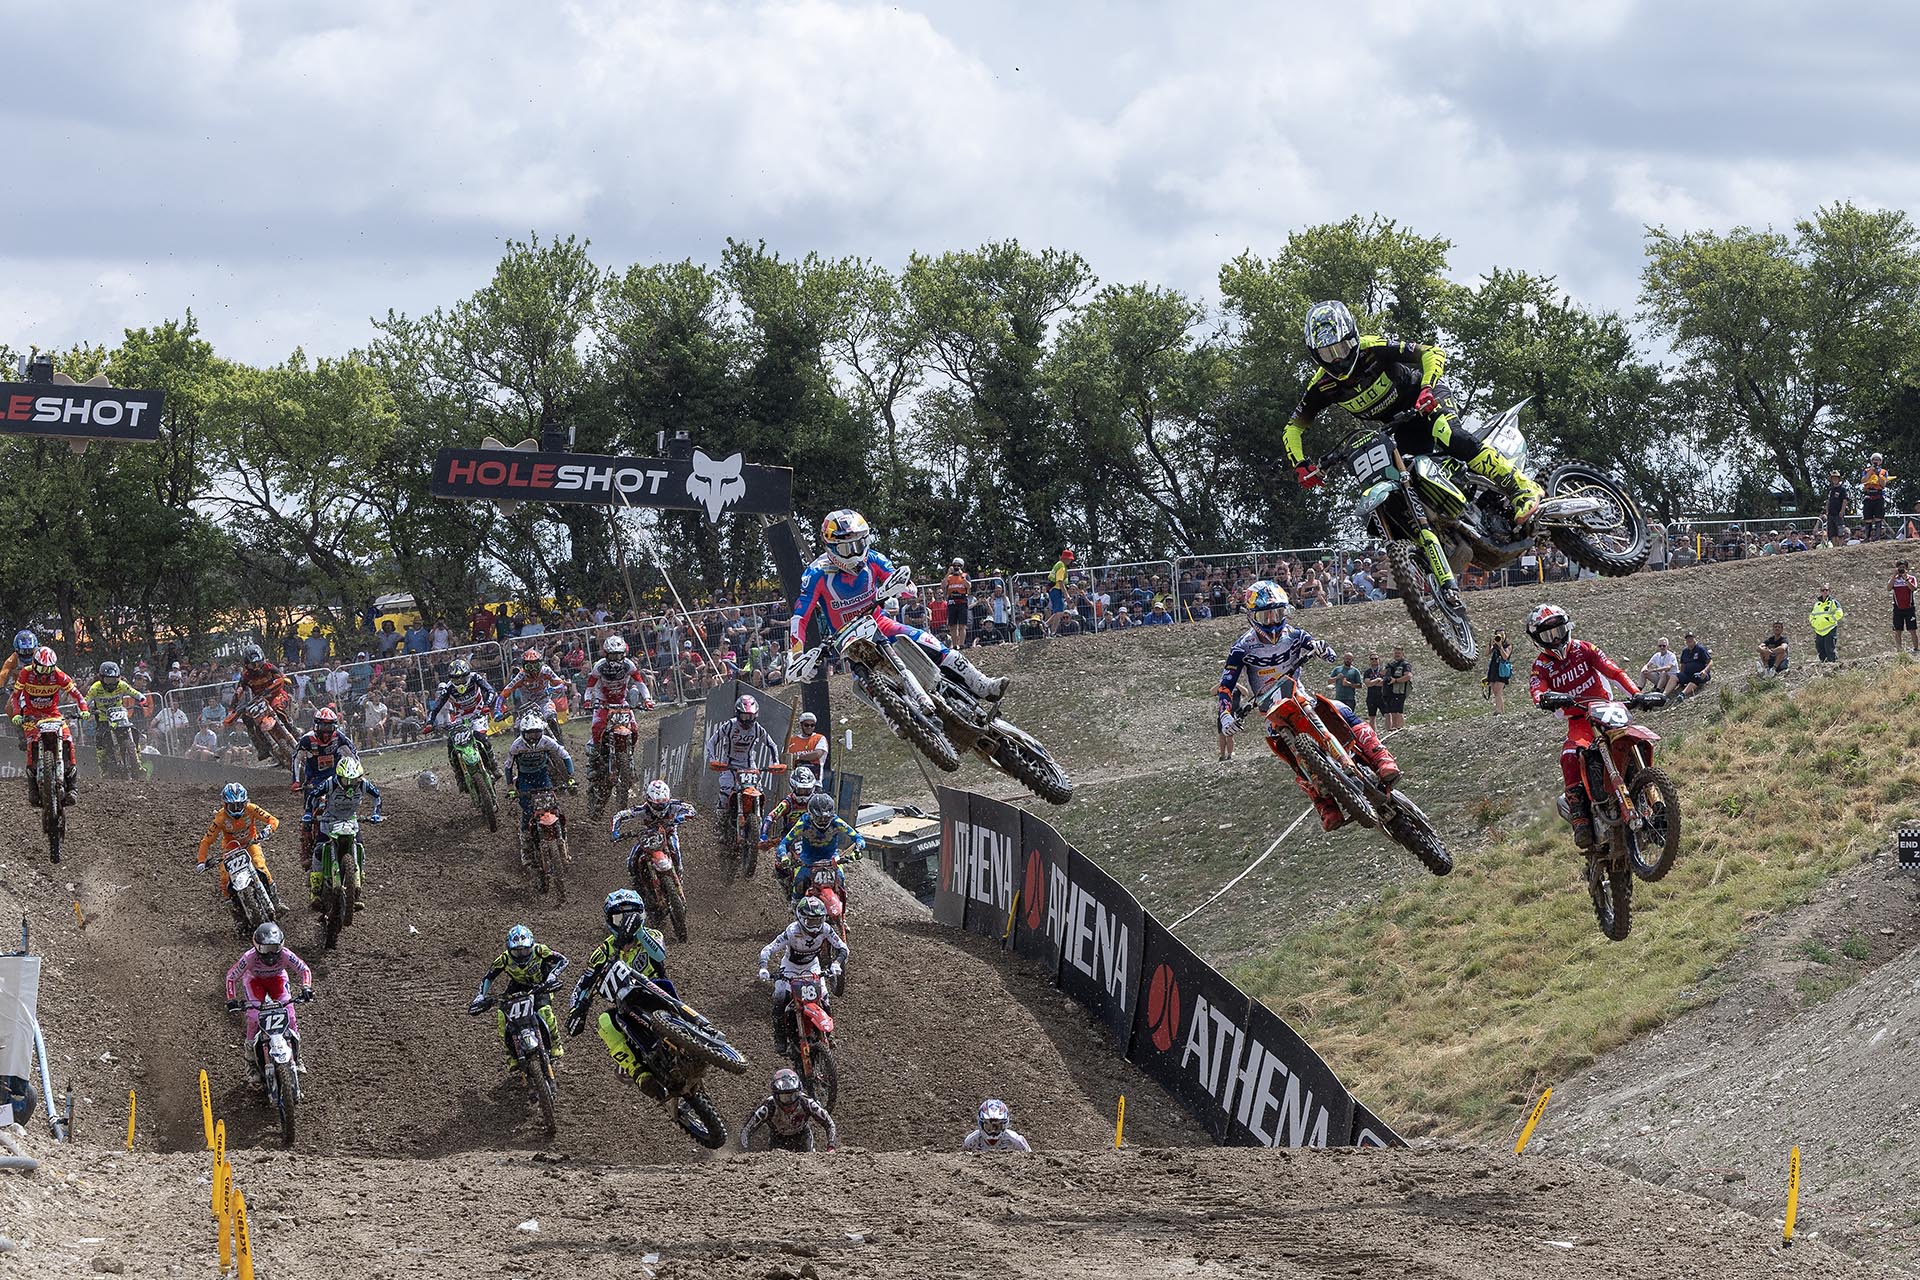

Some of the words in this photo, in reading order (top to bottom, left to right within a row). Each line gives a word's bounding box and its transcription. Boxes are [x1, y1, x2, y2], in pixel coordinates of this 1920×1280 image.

[0, 395, 148, 427] ESHOT
[448, 459, 669, 494] HOLESHOT
[1353, 443, 1391, 483] 99
[1596, 707, 1629, 723] 73
[952, 820, 1013, 914] ATHENA
[643, 934, 659, 953] YAMAHA
[1046, 862, 1128, 1013] ATHENA
[264, 1014, 285, 1031] 12
[510, 1000, 531, 1019] 47
[238, 1208, 248, 1256] ACERBIS
